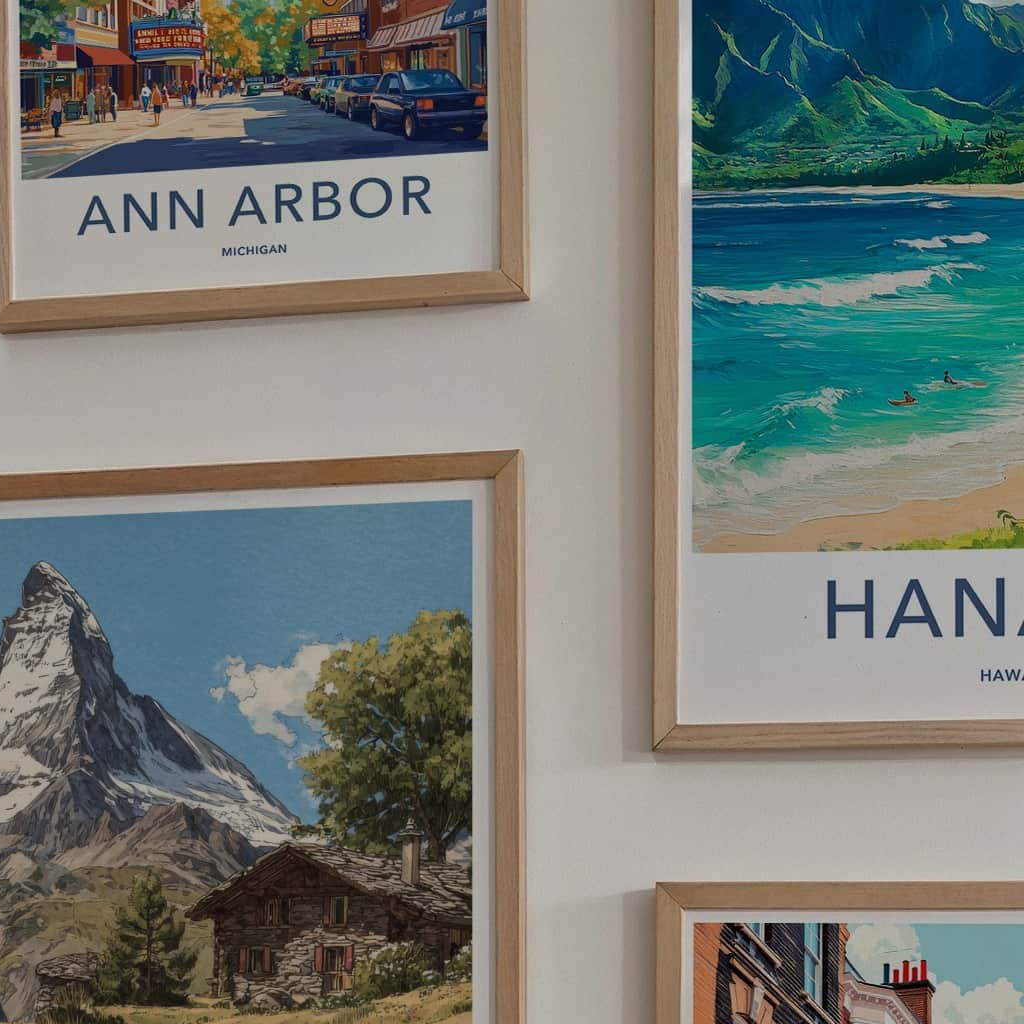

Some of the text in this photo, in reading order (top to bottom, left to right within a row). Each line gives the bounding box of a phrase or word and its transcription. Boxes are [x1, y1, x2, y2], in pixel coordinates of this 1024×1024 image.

[77, 175, 432, 236] ANN ARBOR
[221, 243, 287, 257] MICHIGAN
[827, 577, 1024, 639] HAN
[980, 668, 1024, 682] HAW
